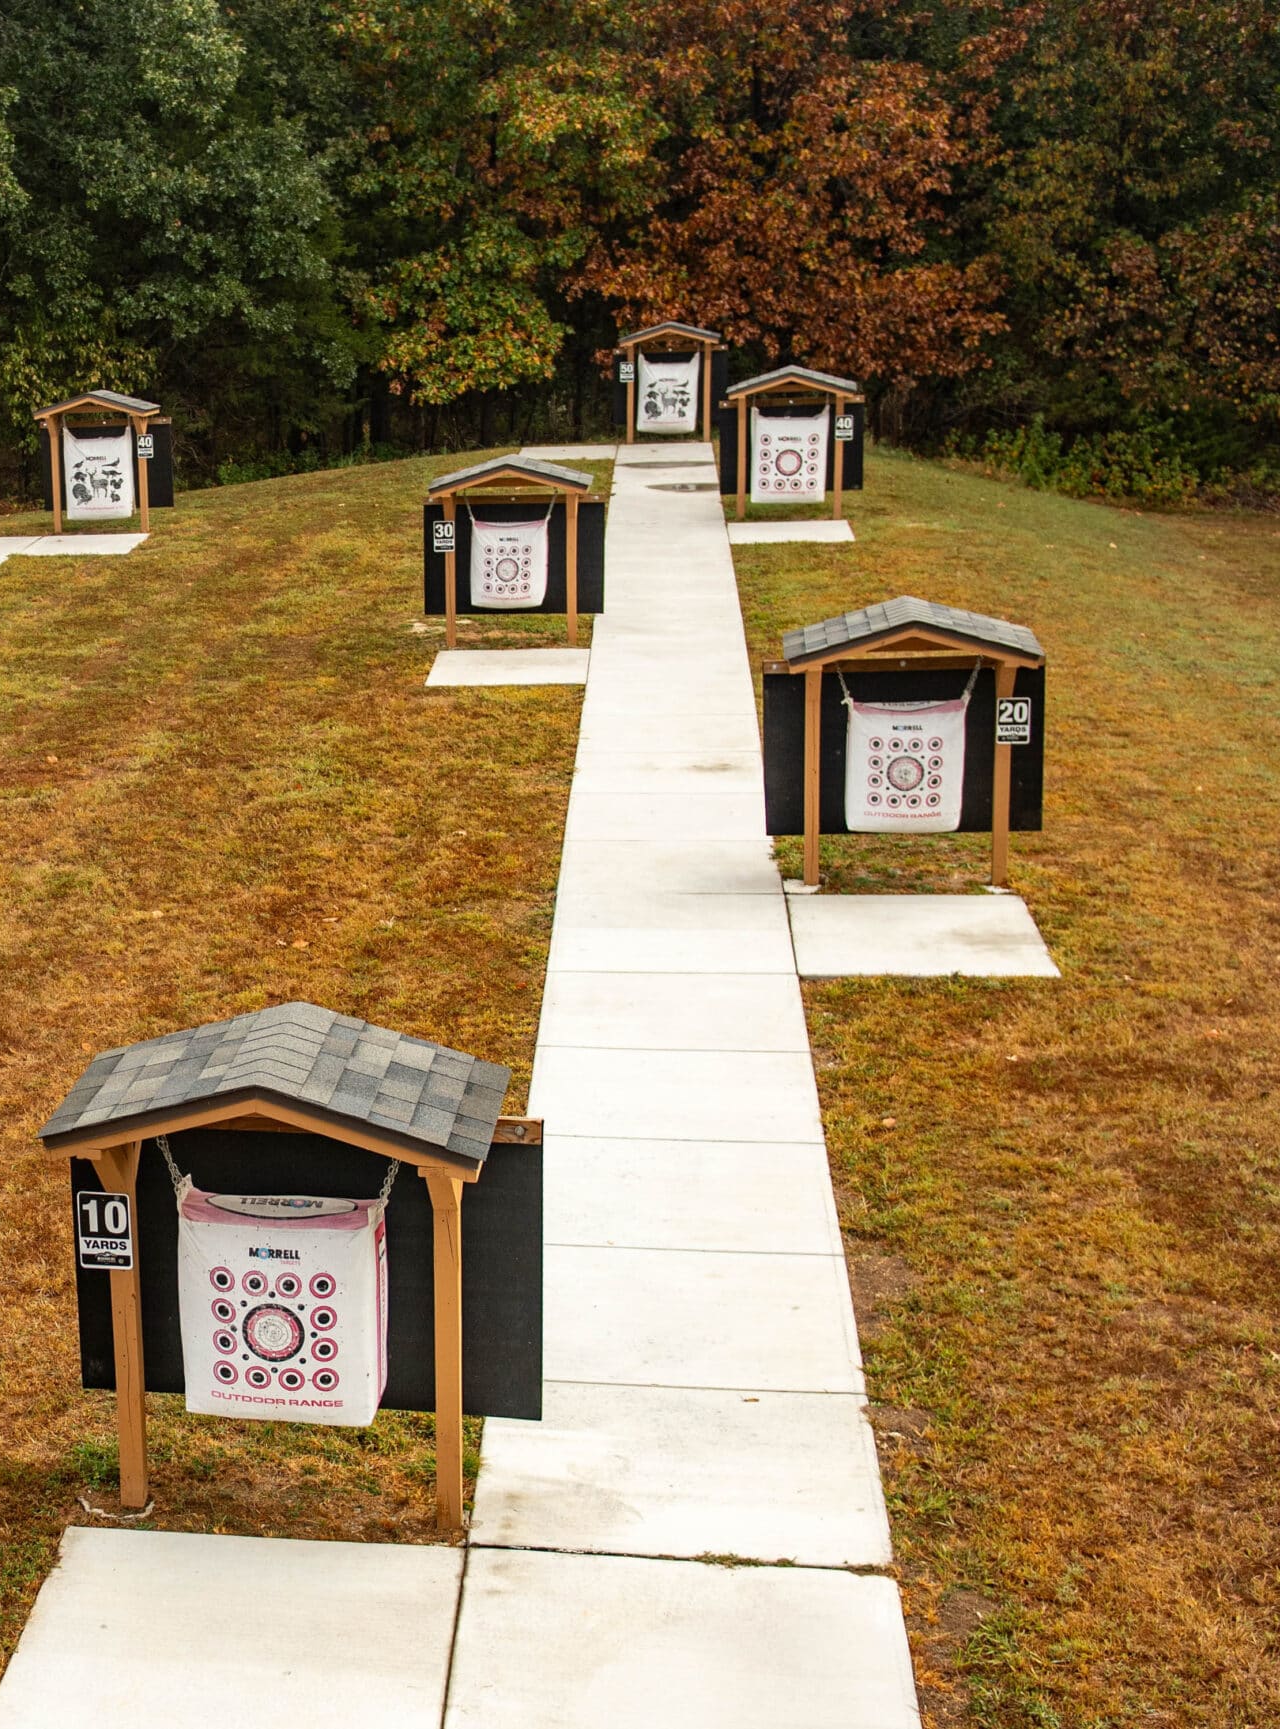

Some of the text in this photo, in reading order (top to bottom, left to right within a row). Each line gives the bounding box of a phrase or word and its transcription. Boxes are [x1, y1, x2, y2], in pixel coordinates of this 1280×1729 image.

[620, 364, 633, 373] 50
[837, 417, 852, 429] 40
[138, 437, 152, 448] 40
[435, 523, 453, 538] 30
[999, 702, 1028, 723] 20
[82, 1199, 127, 1234] 10
[84, 1239, 127, 1251] YARDS
[249, 1247, 301, 1260] MORRELL
[211, 1390, 344, 1408] OUTDOOR RANGE
